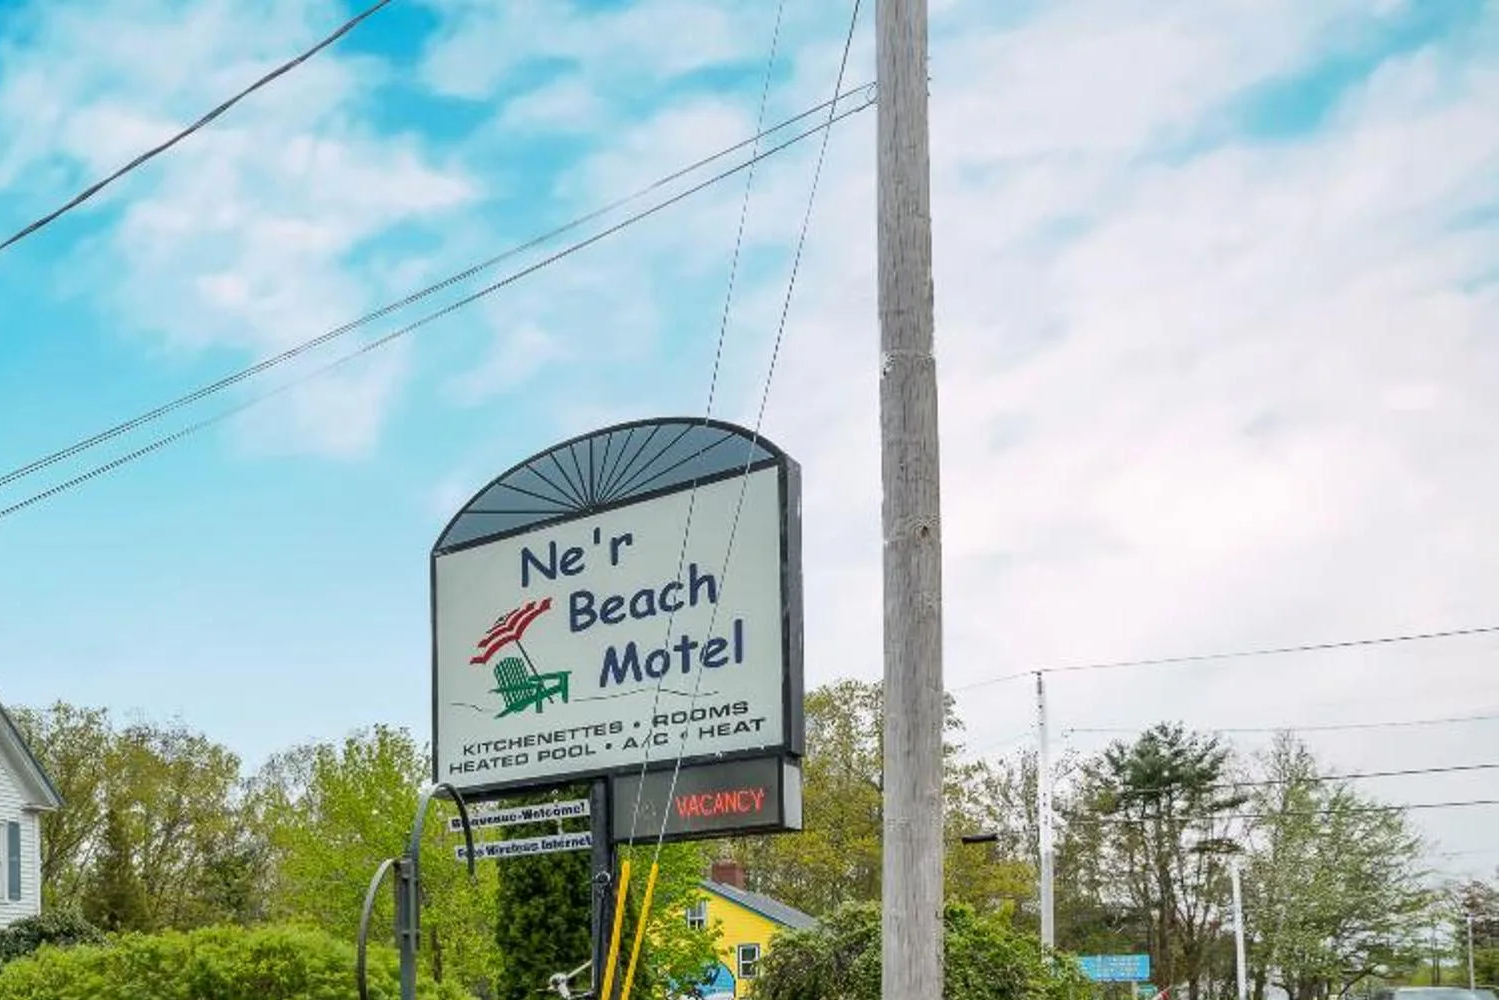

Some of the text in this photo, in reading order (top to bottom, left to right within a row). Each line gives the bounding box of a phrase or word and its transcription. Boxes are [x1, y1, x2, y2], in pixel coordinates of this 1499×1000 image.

[521, 527, 633, 587] Ne'r
[569, 563, 718, 632] Beach
[600, 619, 743, 687] Motel
[450, 753, 529, 775] HEATED
[538, 744, 596, 762] POOL
[699, 717, 765, 740] HEAT
[463, 701, 749, 756] KITCHENETTES ROOMS
[675, 786, 765, 818] VACANCY
